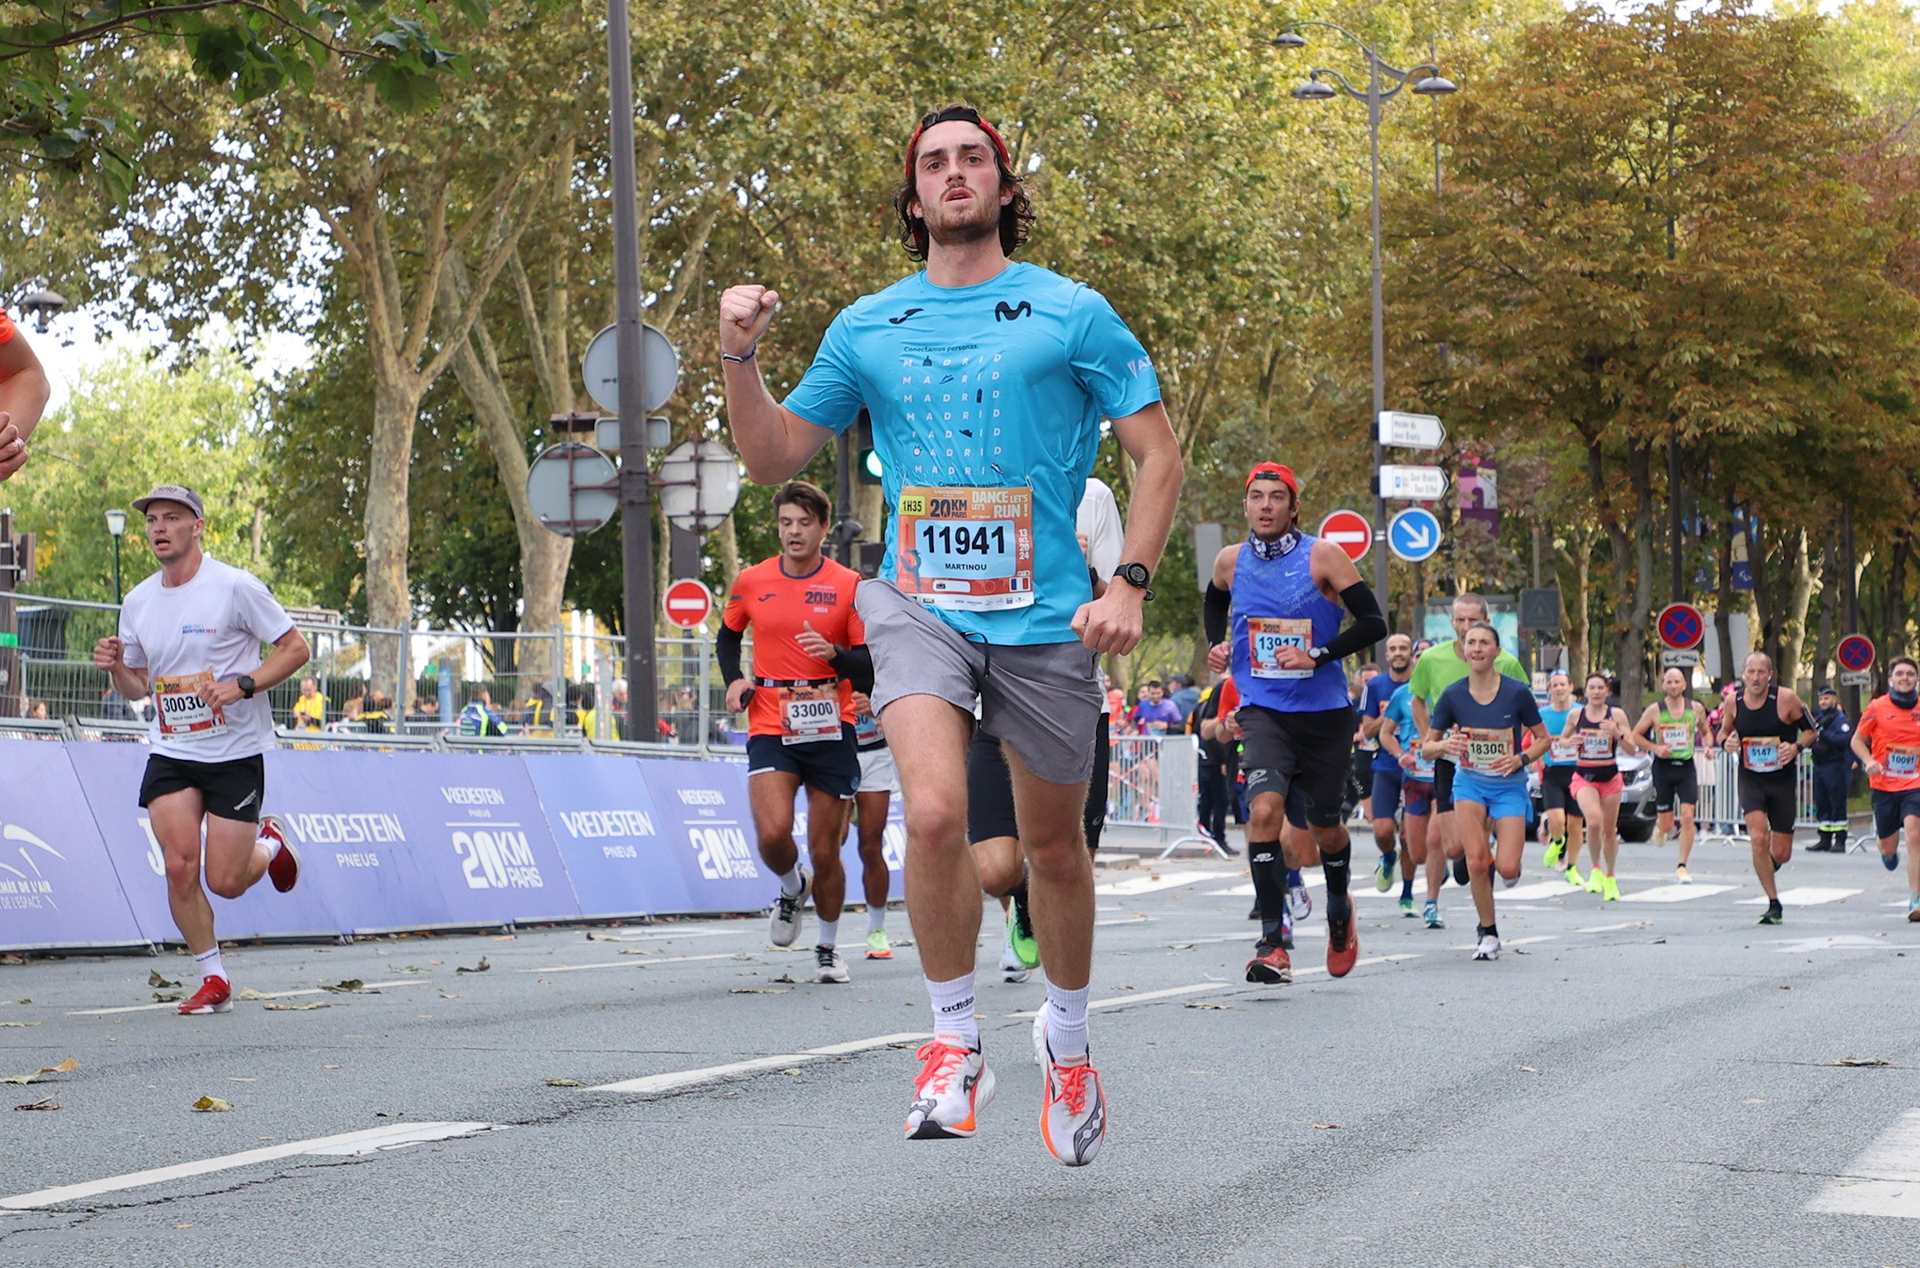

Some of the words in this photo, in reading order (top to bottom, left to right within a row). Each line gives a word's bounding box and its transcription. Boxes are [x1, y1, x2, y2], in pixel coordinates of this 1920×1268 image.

[971, 491, 1009, 504] DANCE
[1010, 494, 1028, 503] LET'S
[903, 501, 922, 512] 1H35
[930, 499, 951, 517] 20
[951, 500, 967, 511] KM
[994, 504, 1021, 518] RUN
[923, 525, 1005, 555] 11941
[1018, 529, 1028, 537] 13
[945, 563, 987, 571] MARTINOU
[805, 591, 823, 604] 20
[823, 592, 837, 600] KM
[791, 702, 833, 718] 33000
[1891, 755, 1914, 765] 10091
[441, 787, 505, 805] VREDESTEIN
[676, 790, 726, 805] VREDESTEIN
[284, 813, 406, 843] VREDESTEIN
[559, 810, 655, 838] VREDESTEIN
[452, 831, 509, 889] 20
[493, 831, 535, 866] KM
[603, 846, 637, 859] PNEUS
[688, 828, 734, 879] 20
[717, 828, 752, 859] KM
[336, 853, 379, 868] PNEUS
[730, 860, 759, 879] PARIS
[506, 867, 544, 889] PARIS
